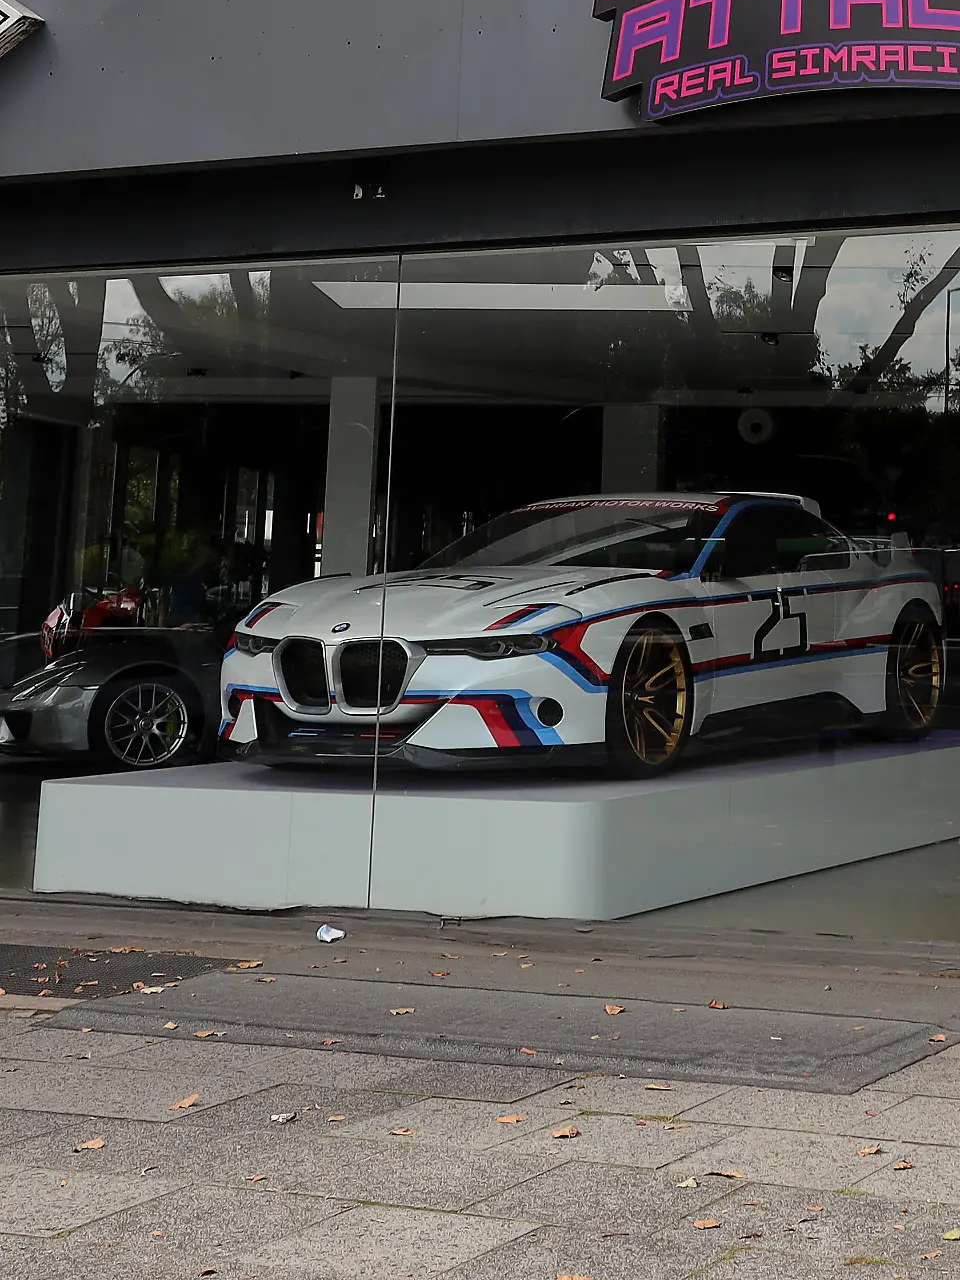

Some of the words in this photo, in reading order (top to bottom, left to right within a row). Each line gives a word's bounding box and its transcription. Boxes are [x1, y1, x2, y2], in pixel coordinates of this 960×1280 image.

[654, 59, 754, 106] REAL
[590, 500, 653, 509] MOTOR
[654, 501, 719, 512] WORKS
